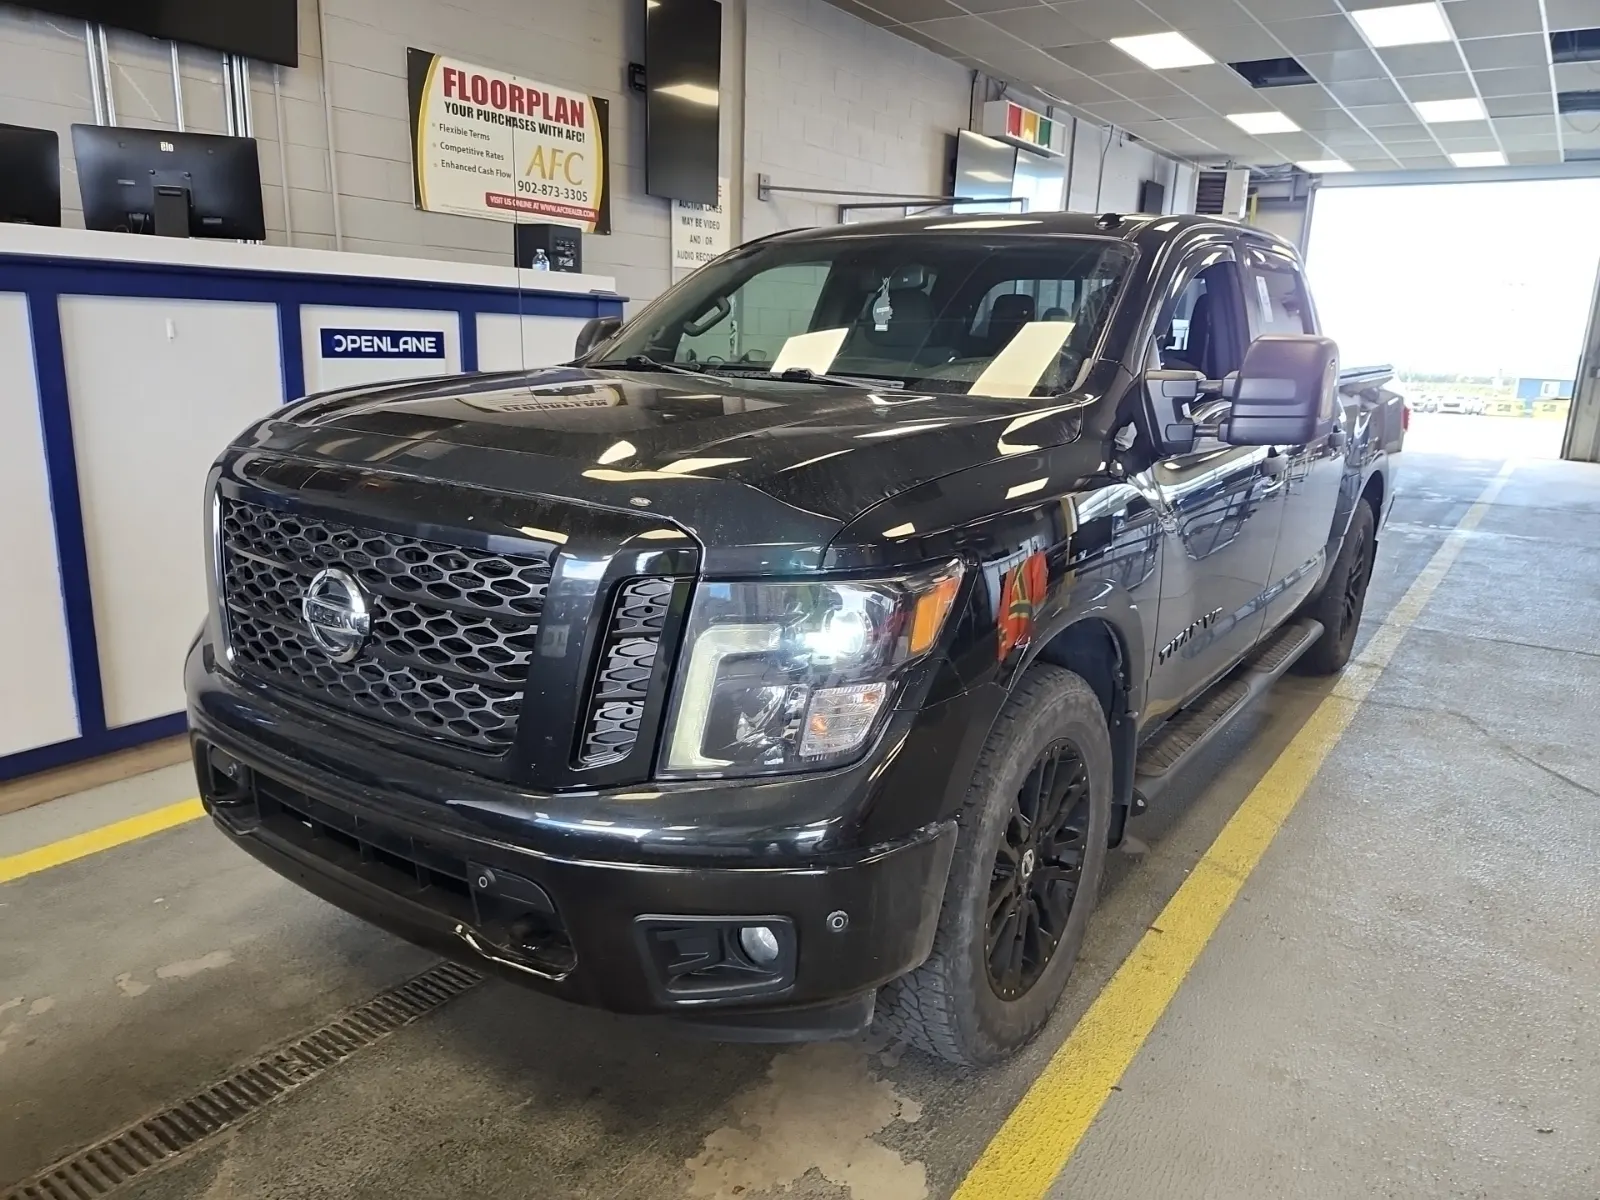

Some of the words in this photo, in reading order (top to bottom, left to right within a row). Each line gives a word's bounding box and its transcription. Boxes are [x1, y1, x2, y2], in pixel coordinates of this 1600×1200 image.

[443, 67, 584, 128] FLOORPLAN
[444, 101, 474, 119] YOUR
[476, 108, 536, 133] PURCHASES
[538, 122, 563, 138] WITH
[565, 129, 585, 143] AFC!
[439, 123, 468, 137] Flexible
[469, 129, 490, 141] Terms
[440, 141, 485, 157] Competitive
[485, 149, 504, 161] Rates
[441, 159, 477, 173] Enhanced
[478, 166, 494, 176] Cash
[495, 168, 512, 179] Flow
[525, 145, 584, 186] AFC
[518, 181, 588, 202] 902-873-3305
[490, 196, 503, 205] VISIT
[504, 198, 512, 206] US
[513, 199, 532, 209] ONLINE
[533, 202, 539, 210] AT
[681, 216, 693, 226] MAY
[695, 218, 702, 228] BE
[703, 219, 720, 231] VIDEO
[690, 234, 701, 244] AND
[705, 236, 713, 245] OR
[677, 249, 695, 261] AUDIO
[333, 335, 437, 353] OPENLANE
